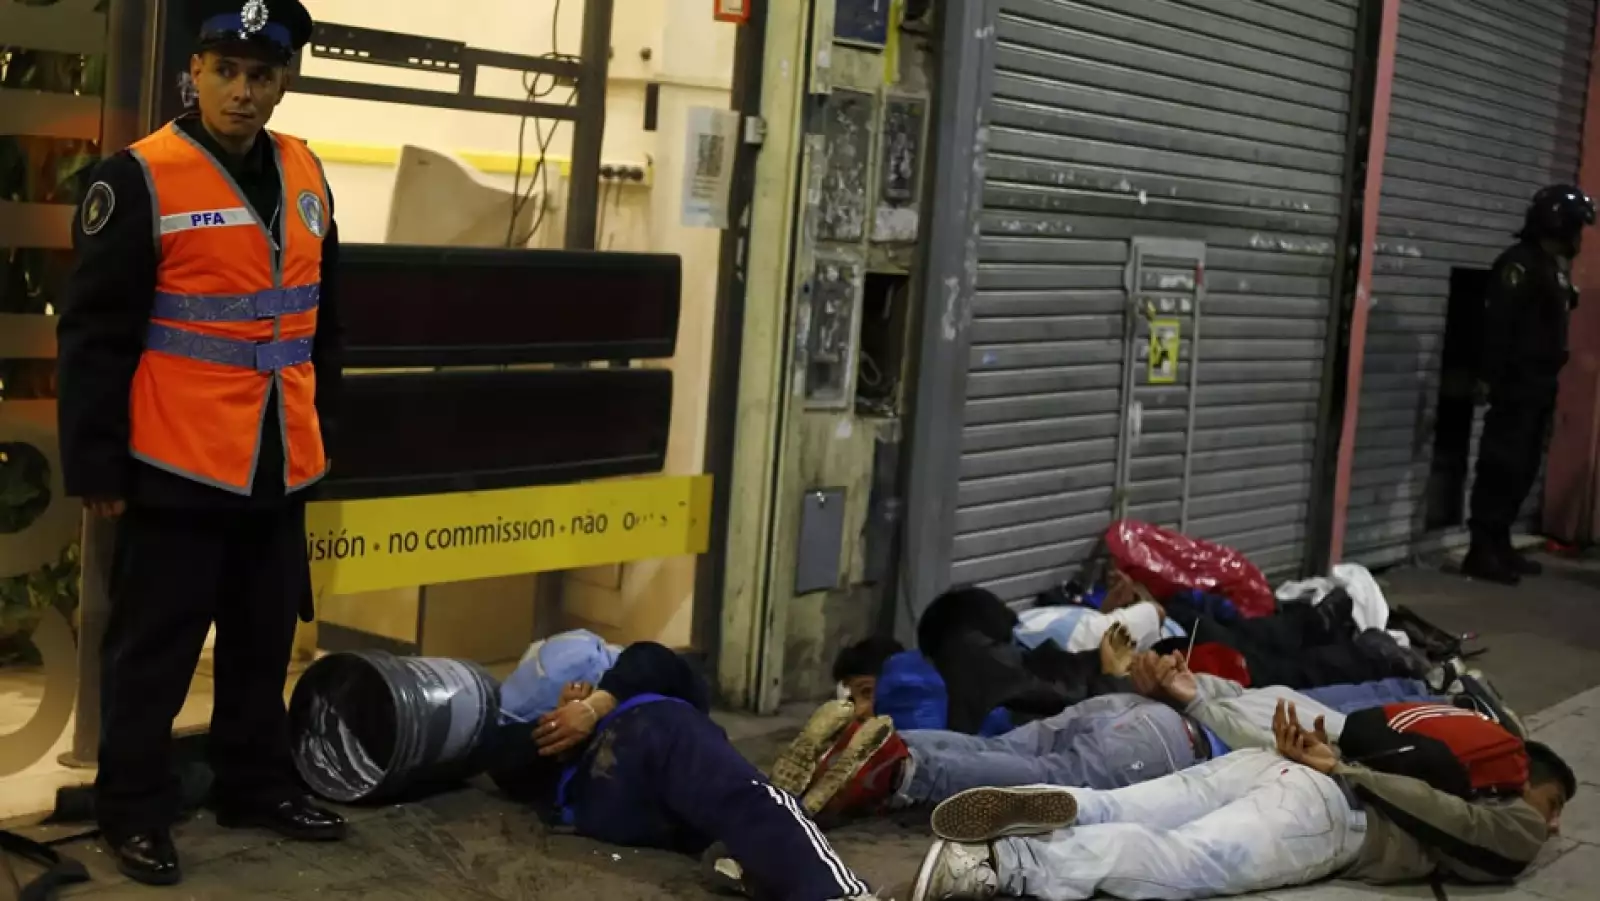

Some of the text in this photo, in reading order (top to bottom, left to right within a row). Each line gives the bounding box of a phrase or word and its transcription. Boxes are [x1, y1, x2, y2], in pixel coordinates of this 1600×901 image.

[191, 212, 226, 226] PFA
[387, 531, 419, 553] no
[424, 516, 554, 550] commission
